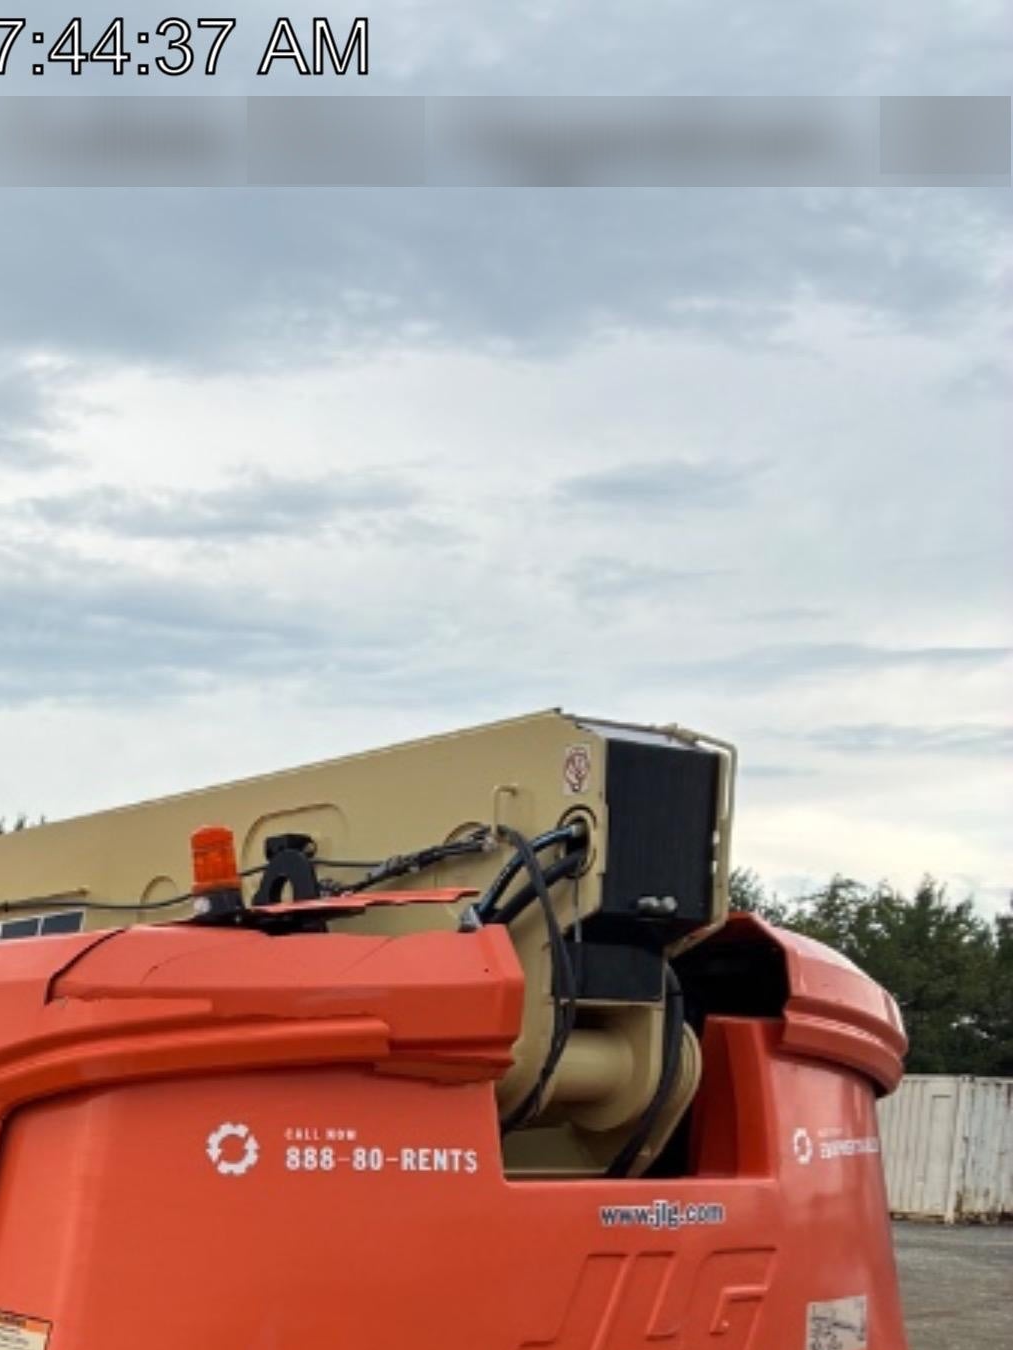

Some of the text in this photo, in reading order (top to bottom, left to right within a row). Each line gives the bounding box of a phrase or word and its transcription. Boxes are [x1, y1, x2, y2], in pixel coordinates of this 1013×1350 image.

[284, 1127, 320, 1141] CALL
[286, 1146, 479, 1173] 888-80-RENTS
[600, 1200, 725, 1229] www.jlg.com
